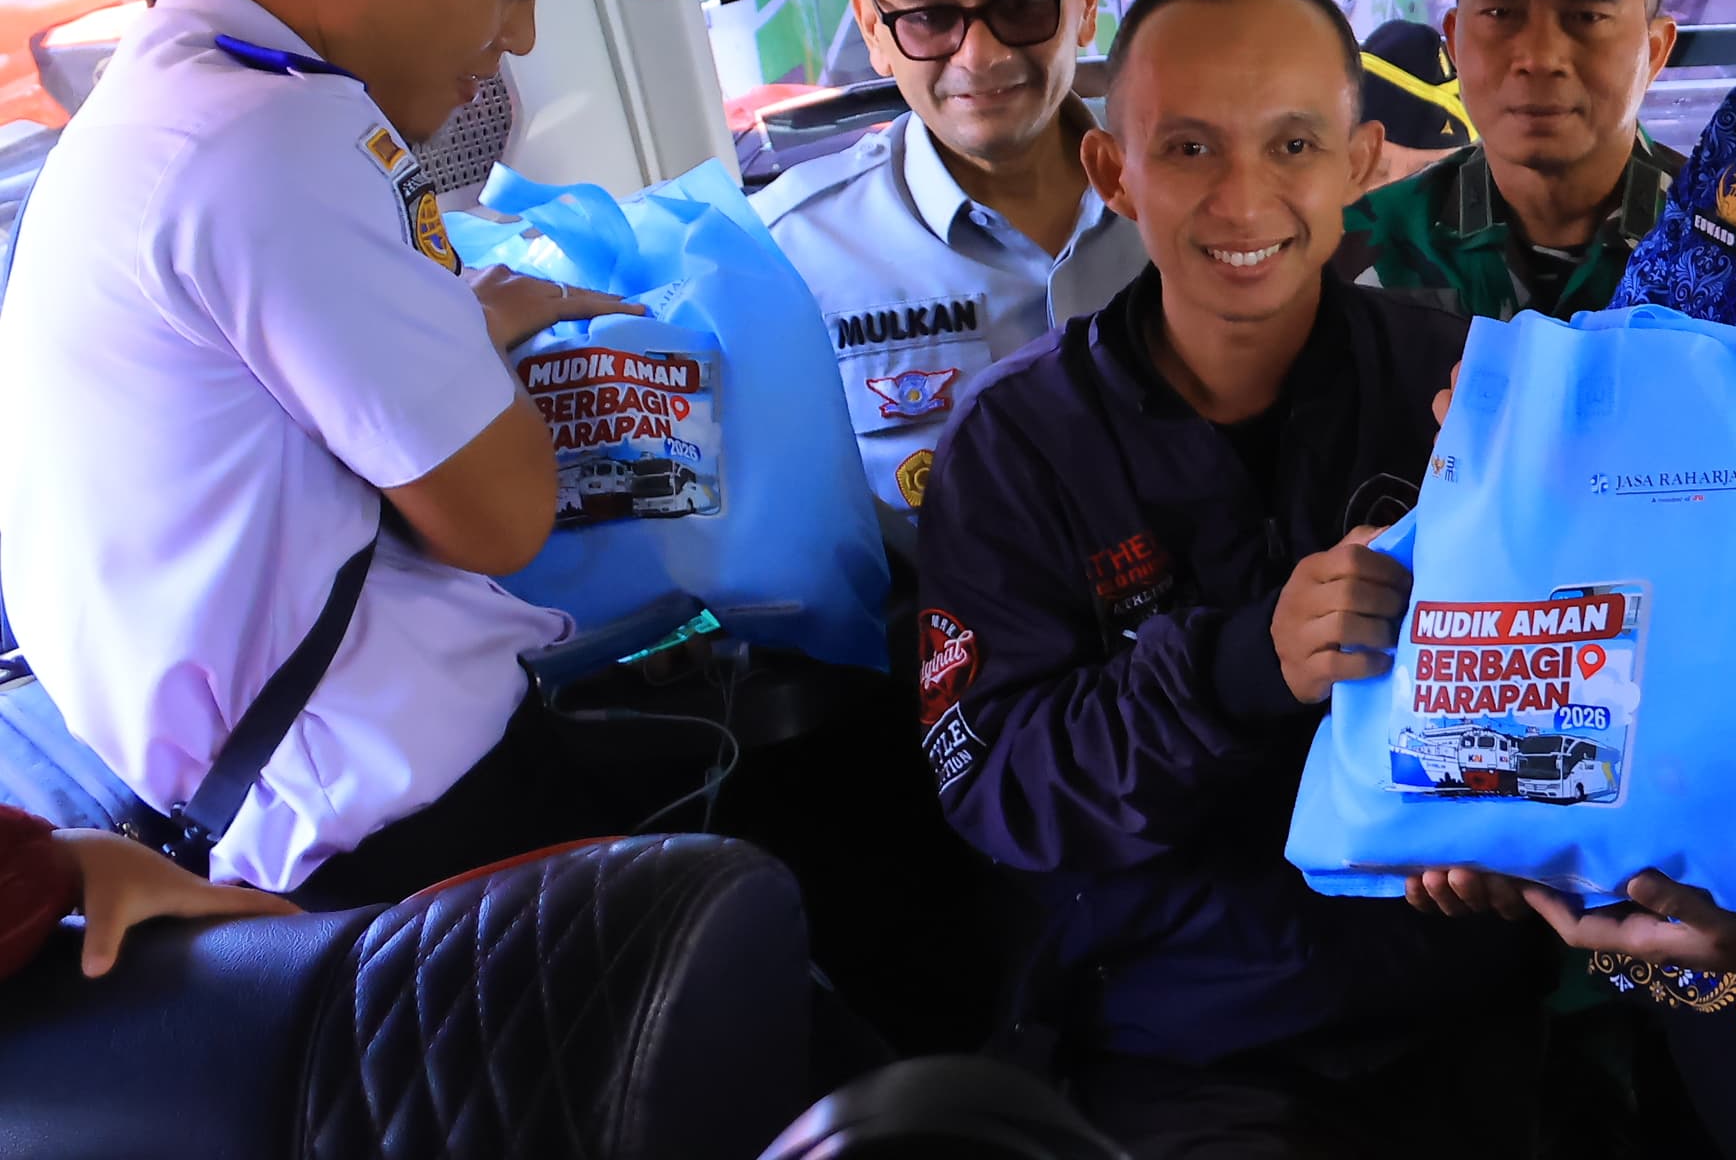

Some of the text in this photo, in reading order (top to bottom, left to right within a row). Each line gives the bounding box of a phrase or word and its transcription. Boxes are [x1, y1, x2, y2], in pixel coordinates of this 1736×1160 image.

[838, 300, 977, 349] MULKAN
[528, 354, 687, 388] MUDIK AMAN
[534, 386, 670, 424] BERBAGI
[550, 415, 673, 452] ARAPAN
[667, 439, 699, 461] 2026
[1615, 474, 1653, 490] JASA
[1417, 603, 1608, 638] MUDIK AMAN
[1415, 646, 1573, 682] BERBAGI
[1413, 681, 1570, 714] HARAPAN
[1558, 707, 1607, 730] 2026
